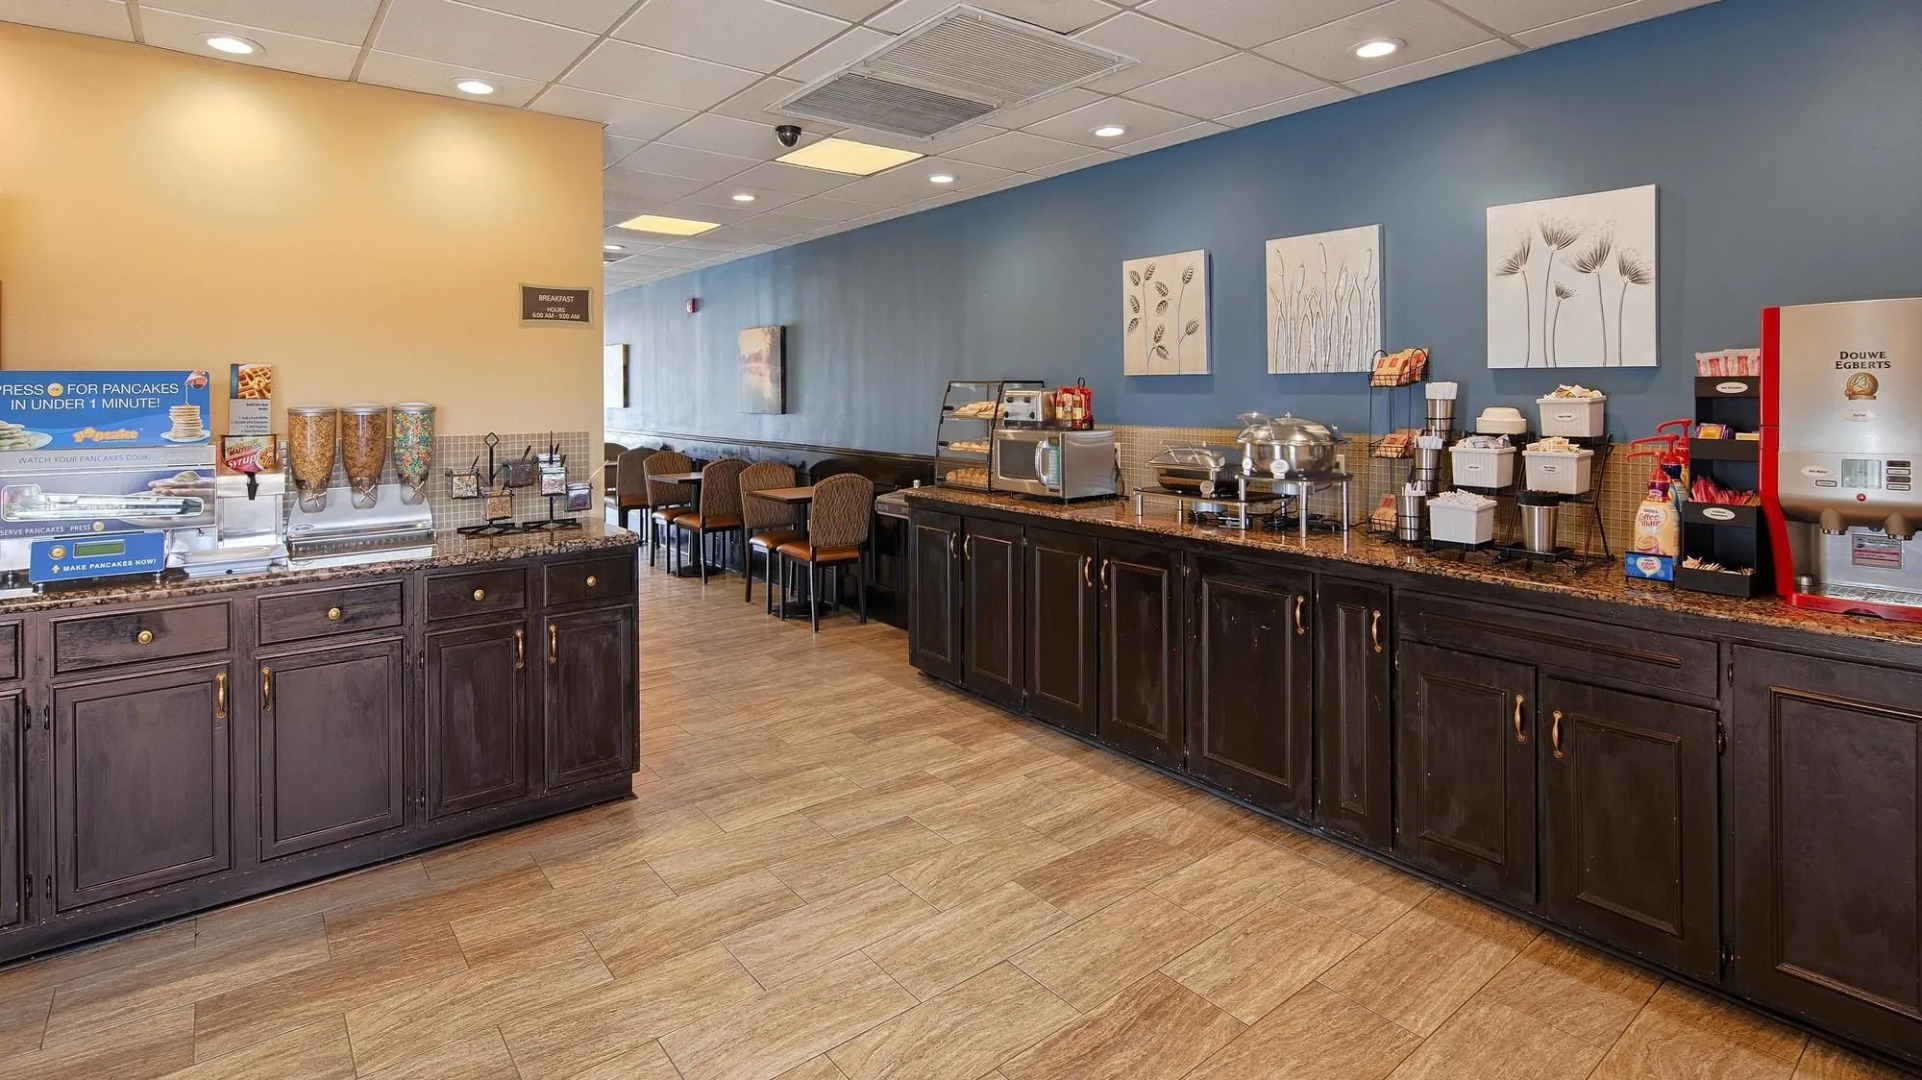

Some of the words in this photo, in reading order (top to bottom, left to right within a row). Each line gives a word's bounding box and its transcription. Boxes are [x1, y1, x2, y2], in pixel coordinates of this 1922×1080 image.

[1840, 351, 1887, 360] DOUWE
[1835, 360, 1892, 370] EGBERTS
[0, 384, 44, 396] RESS
[67, 383, 98, 395] FOR
[102, 382, 179, 395] PANCAKES
[11, 399, 26, 410] IN
[31, 398, 85, 410] UNDER
[89, 398, 96, 409] 1
[101, 397, 160, 409] MINUTE!
[18, 456, 51, 464] WATCH
[79, 454, 123, 462] PANCAKES
[228, 455, 257, 468] Syrup
[89, 560, 133, 570] PANCAKES
[135, 558, 157, 566] NOW!
